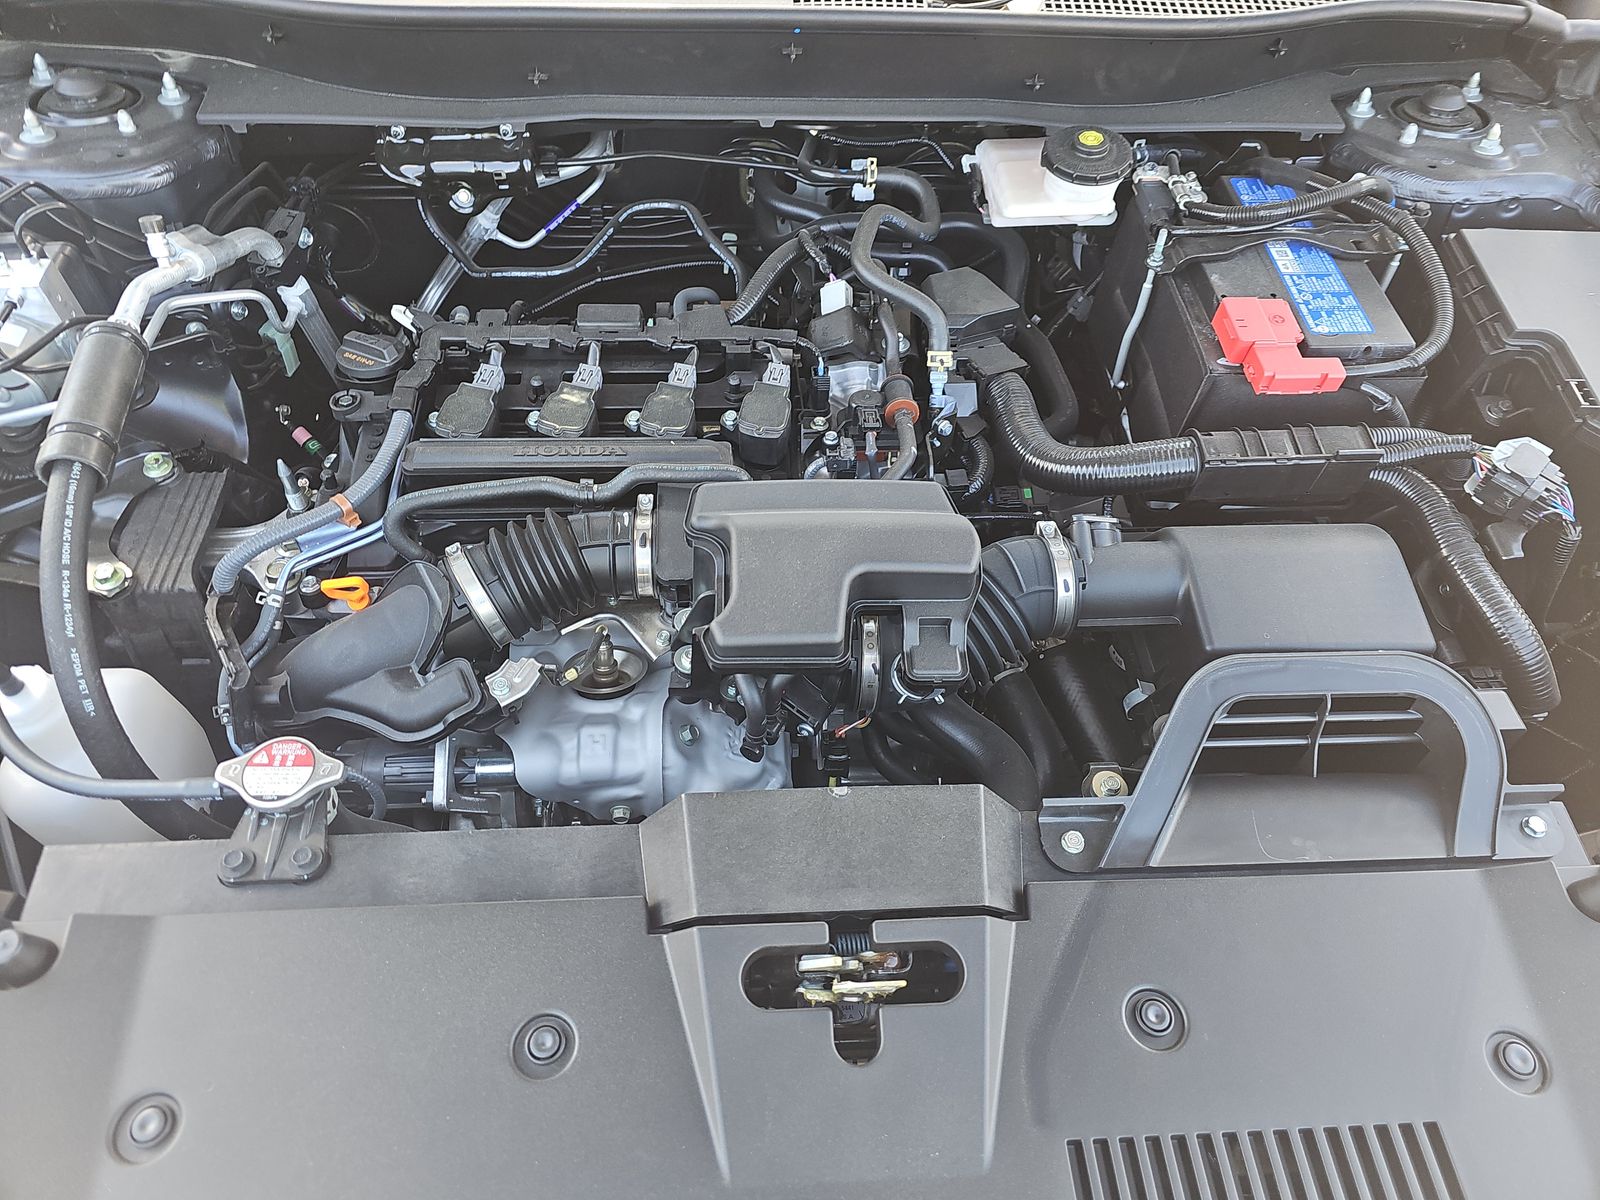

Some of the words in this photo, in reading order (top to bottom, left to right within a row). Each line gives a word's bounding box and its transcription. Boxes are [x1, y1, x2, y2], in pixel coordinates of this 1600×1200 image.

[513, 445, 627, 457] HONDA
[64, 518, 73, 528] ID
[63, 527, 72, 542] A/C
[62, 542, 71, 565] HOSE
[62, 569, 71, 598] R-134a
[77, 678, 90, 695] PET
